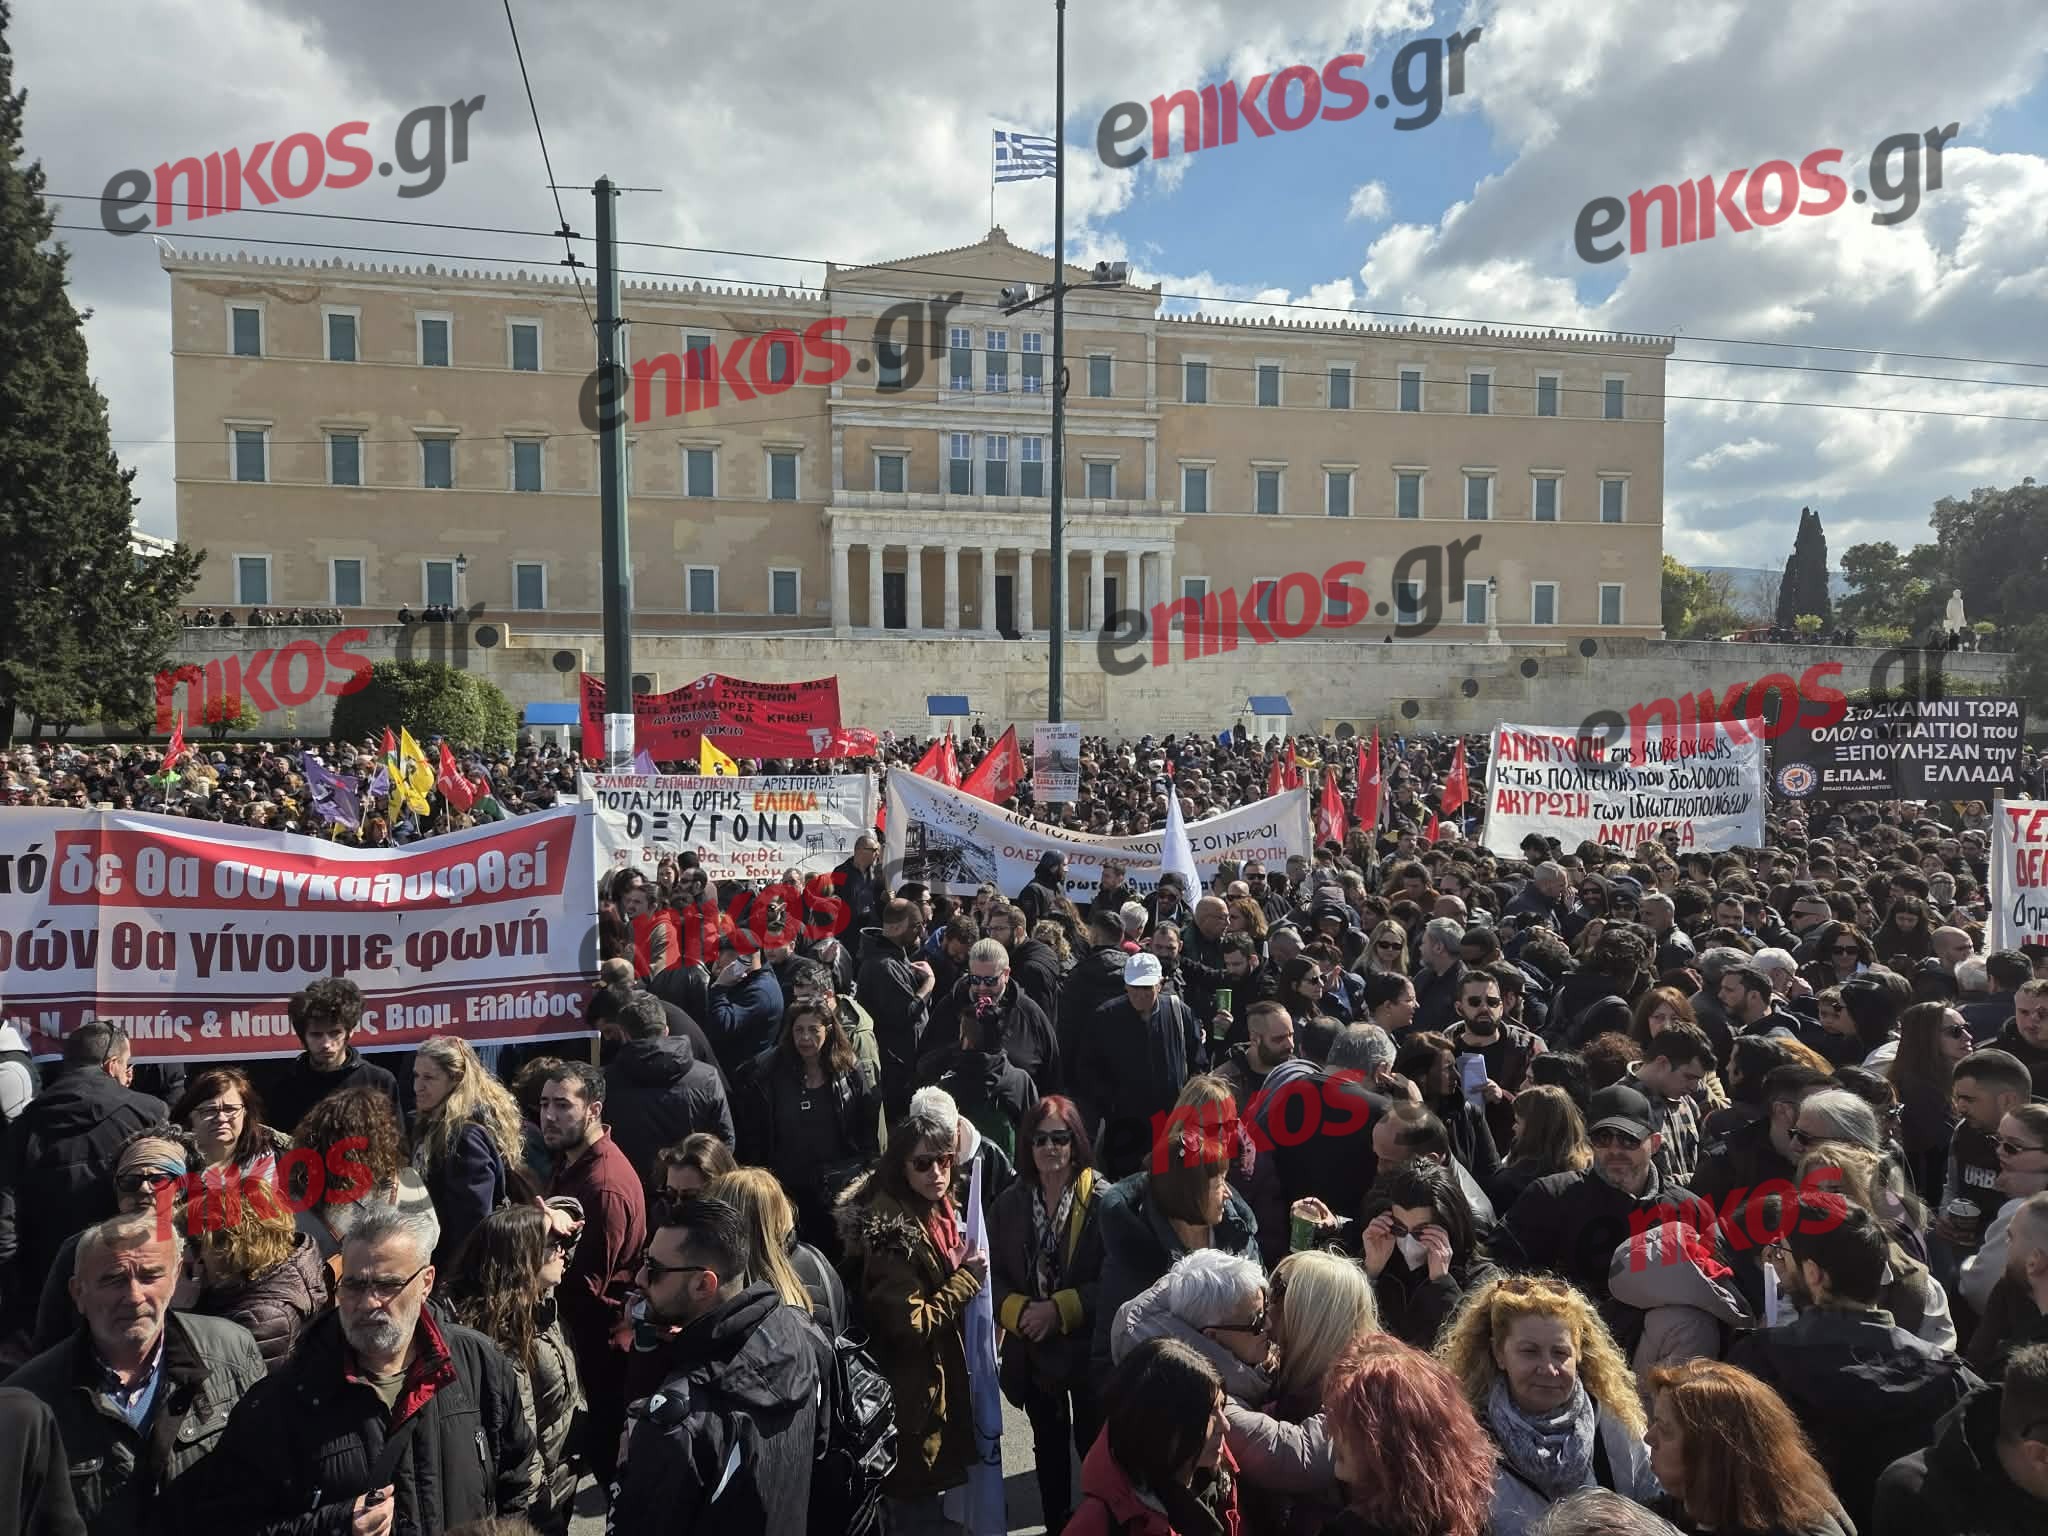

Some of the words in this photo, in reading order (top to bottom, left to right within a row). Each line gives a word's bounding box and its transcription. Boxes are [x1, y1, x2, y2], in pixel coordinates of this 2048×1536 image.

[1874, 701, 1959, 718] ΣΚΑΜΝΙ
[1964, 701, 2020, 718] ΤΩΡΑ
[1883, 722, 1978, 739] ΥΠΑΙΤΙΟΙ
[1982, 725, 2019, 740] που
[1498, 731, 1606, 764] ΑΝΑΤΡΟΠΗ
[1835, 743, 1980, 762] ΞΕΠΟΥΛΗΣΑΝ
[1983, 747, 2017, 764] την
[1924, 764, 2015, 783] ΕΛΛΑΔΑ
[597, 790, 684, 810] ΠΟΤΑΜΙΑ
[753, 791, 819, 812] ΕΛΠΙΔΑ
[826, 791, 839, 809] ΚΙ
[1495, 789, 1591, 818] ΑΚΥΡΩΣΗ
[626, 811, 804, 843] ΟΞΥΓΟΝΟ
[60, 844, 121, 896] δε
[136, 847, 199, 897] θα
[213, 840, 548, 905] συγκαλυφθεί
[746, 863, 784, 879] δρόμ
[111, 921, 176, 970] θα
[189, 923, 393, 977] γίνουμε
[405, 908, 549, 972] φωνή
[200, 1010, 223, 1038] &
[466, 991, 583, 1022] Ελλάδος
[1964, 1165, 1998, 1188] URB
